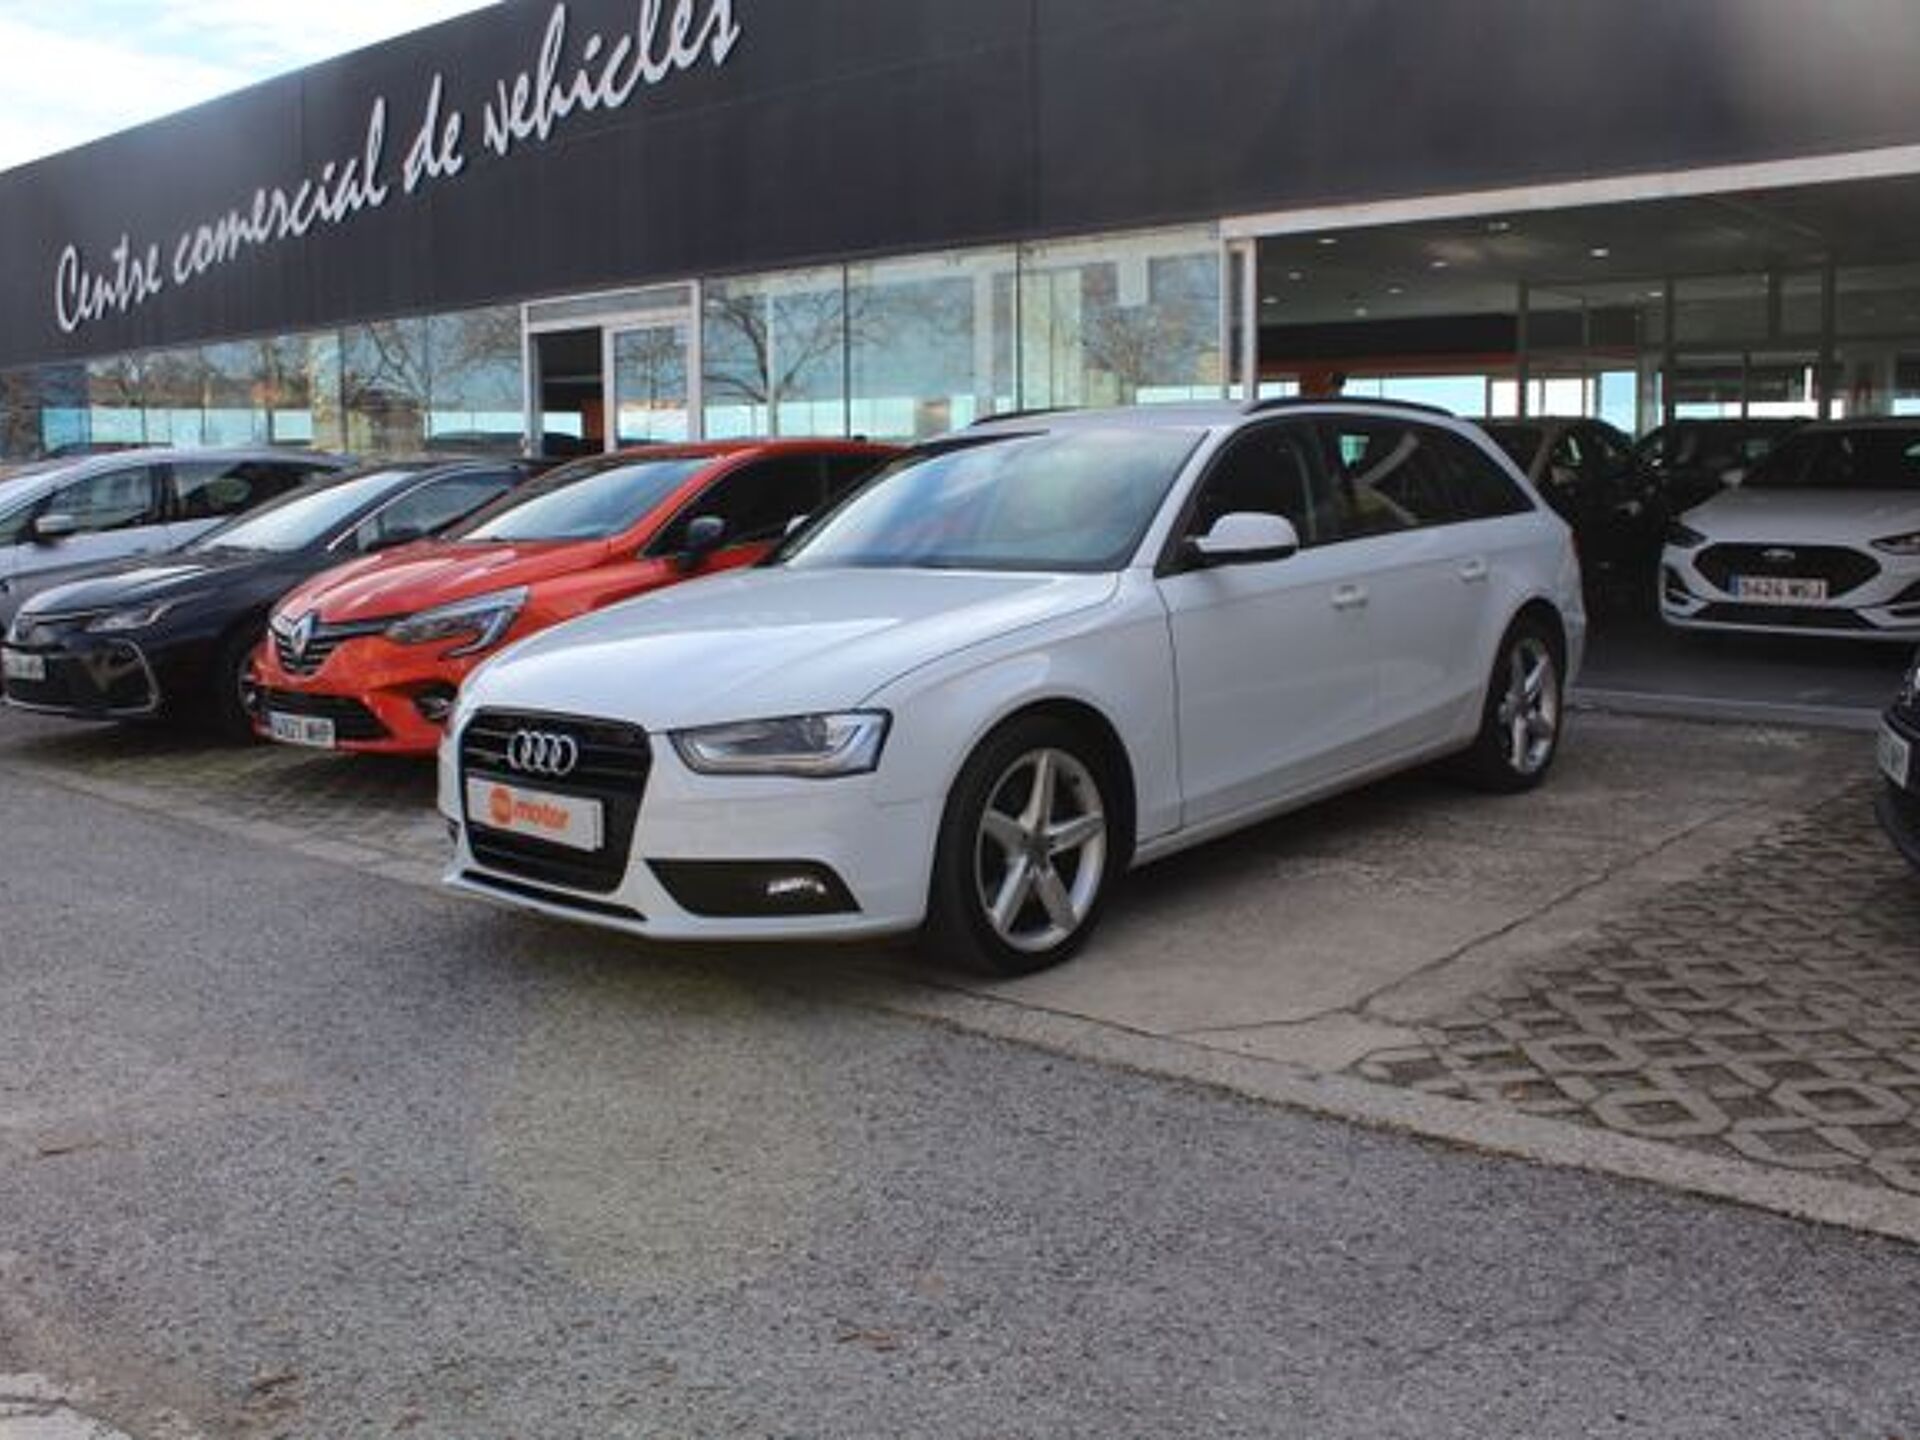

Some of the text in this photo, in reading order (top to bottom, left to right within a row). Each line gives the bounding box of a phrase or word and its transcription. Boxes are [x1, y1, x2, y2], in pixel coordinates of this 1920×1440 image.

[56, 0, 741, 333] Centre comercial de vehicles
